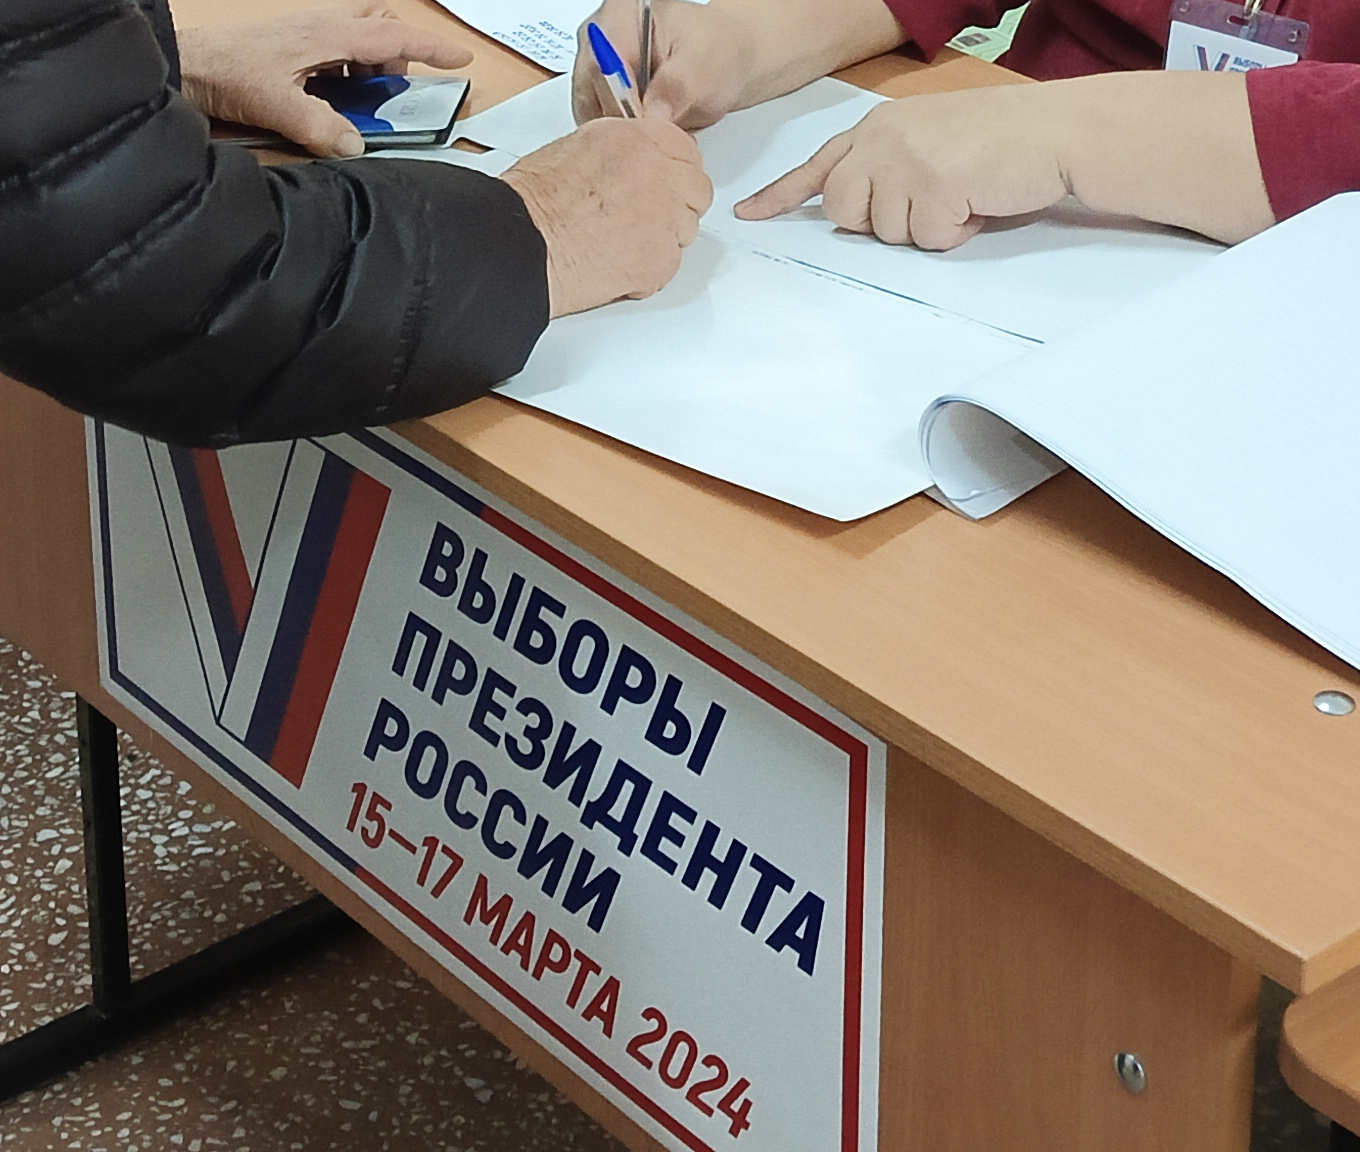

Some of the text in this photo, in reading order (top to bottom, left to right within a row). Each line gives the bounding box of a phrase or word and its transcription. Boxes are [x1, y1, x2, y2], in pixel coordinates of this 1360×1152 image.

[419, 520, 728, 776] ВЫБОРЫ
[363, 696, 623, 934] РОССИИ
[391, 610, 828, 978] ПРЕЗИДЕНТА
[463, 873, 622, 1038] МАРТА
[626, 1007, 755, 1139] 2024
